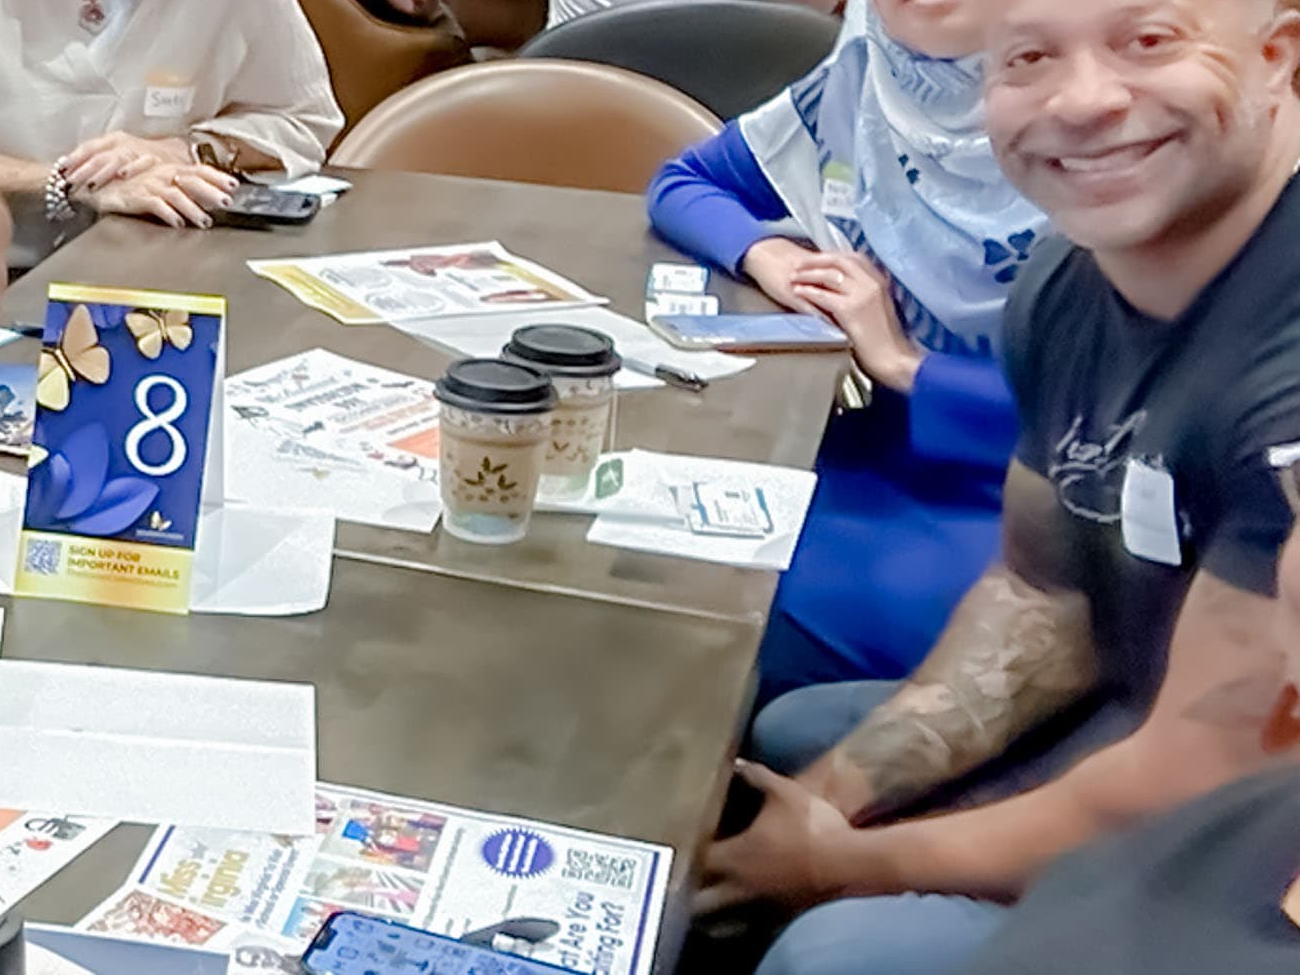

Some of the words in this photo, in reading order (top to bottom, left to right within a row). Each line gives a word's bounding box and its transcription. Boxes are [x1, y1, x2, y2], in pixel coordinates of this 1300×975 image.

[124, 374, 189, 477] 8
[68, 545, 96, 557] SIGN
[97, 549, 115, 560] UP
[116, 551, 141, 563] FOR
[67, 557, 135, 574] IMPORTANT
[137, 565, 180, 580] EMAILS
[564, 890, 596, 915] You
